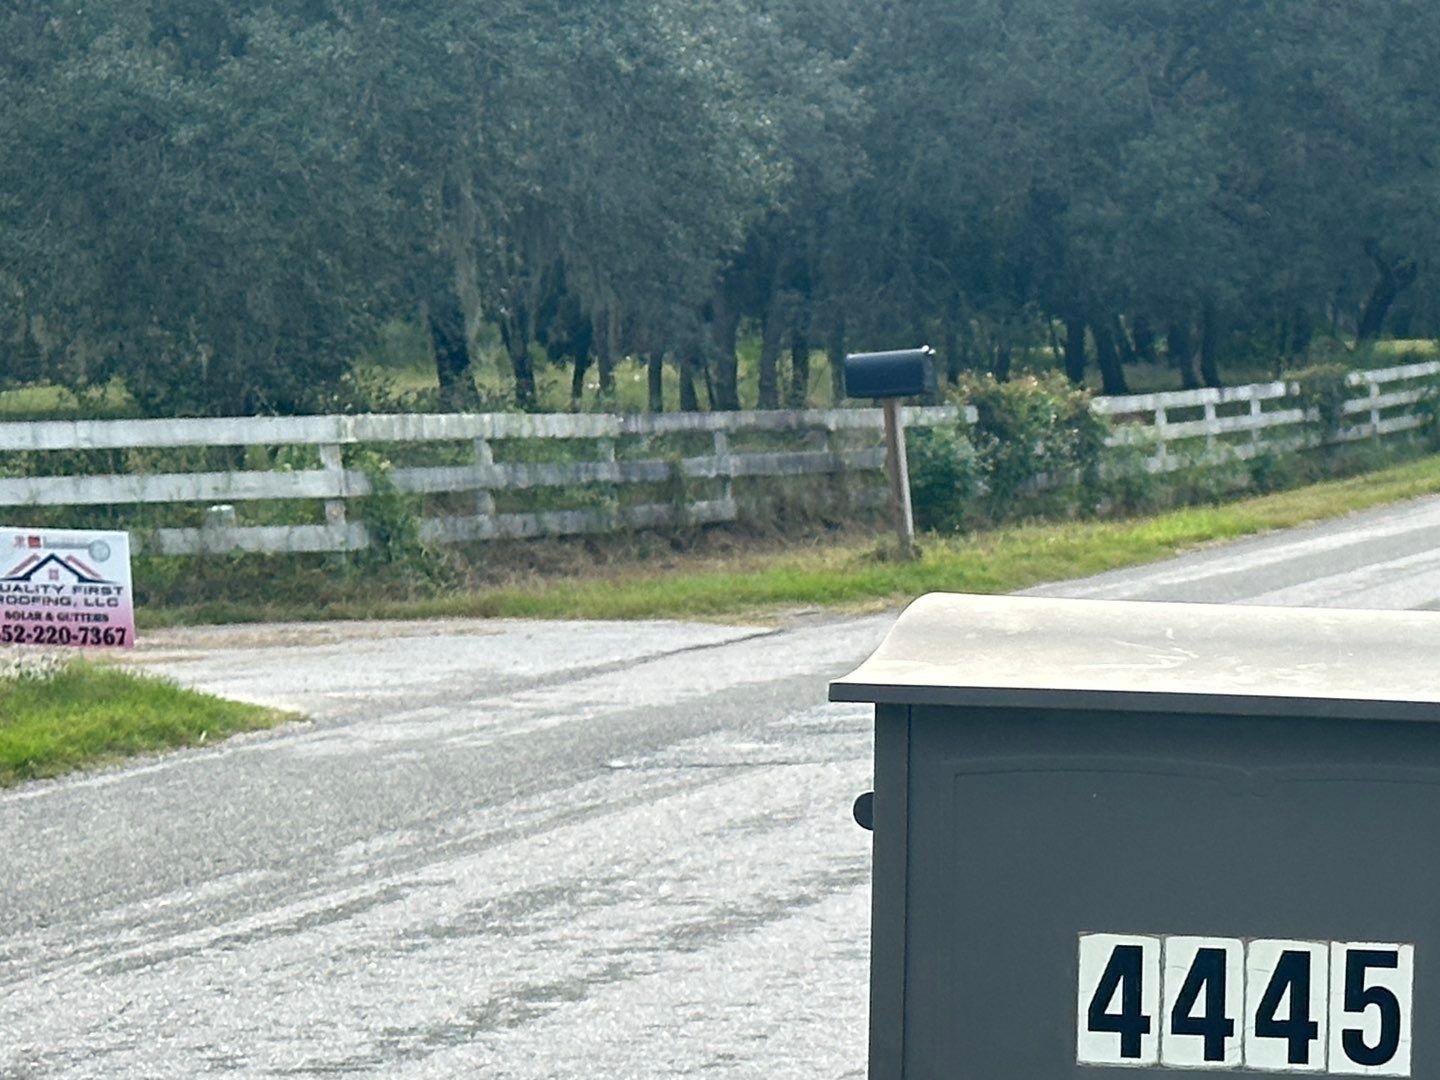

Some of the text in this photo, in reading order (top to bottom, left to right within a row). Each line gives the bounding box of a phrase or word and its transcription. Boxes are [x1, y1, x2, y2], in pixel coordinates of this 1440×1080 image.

[0, 583, 123, 596] UALITY FIRST
[84, 597, 119, 608] LLC
[4, 610, 109, 623] SOLAR & GUTTERS
[0, 624, 126, 646] 52-220-7367
[1088, 944, 1401, 1067] 4445
